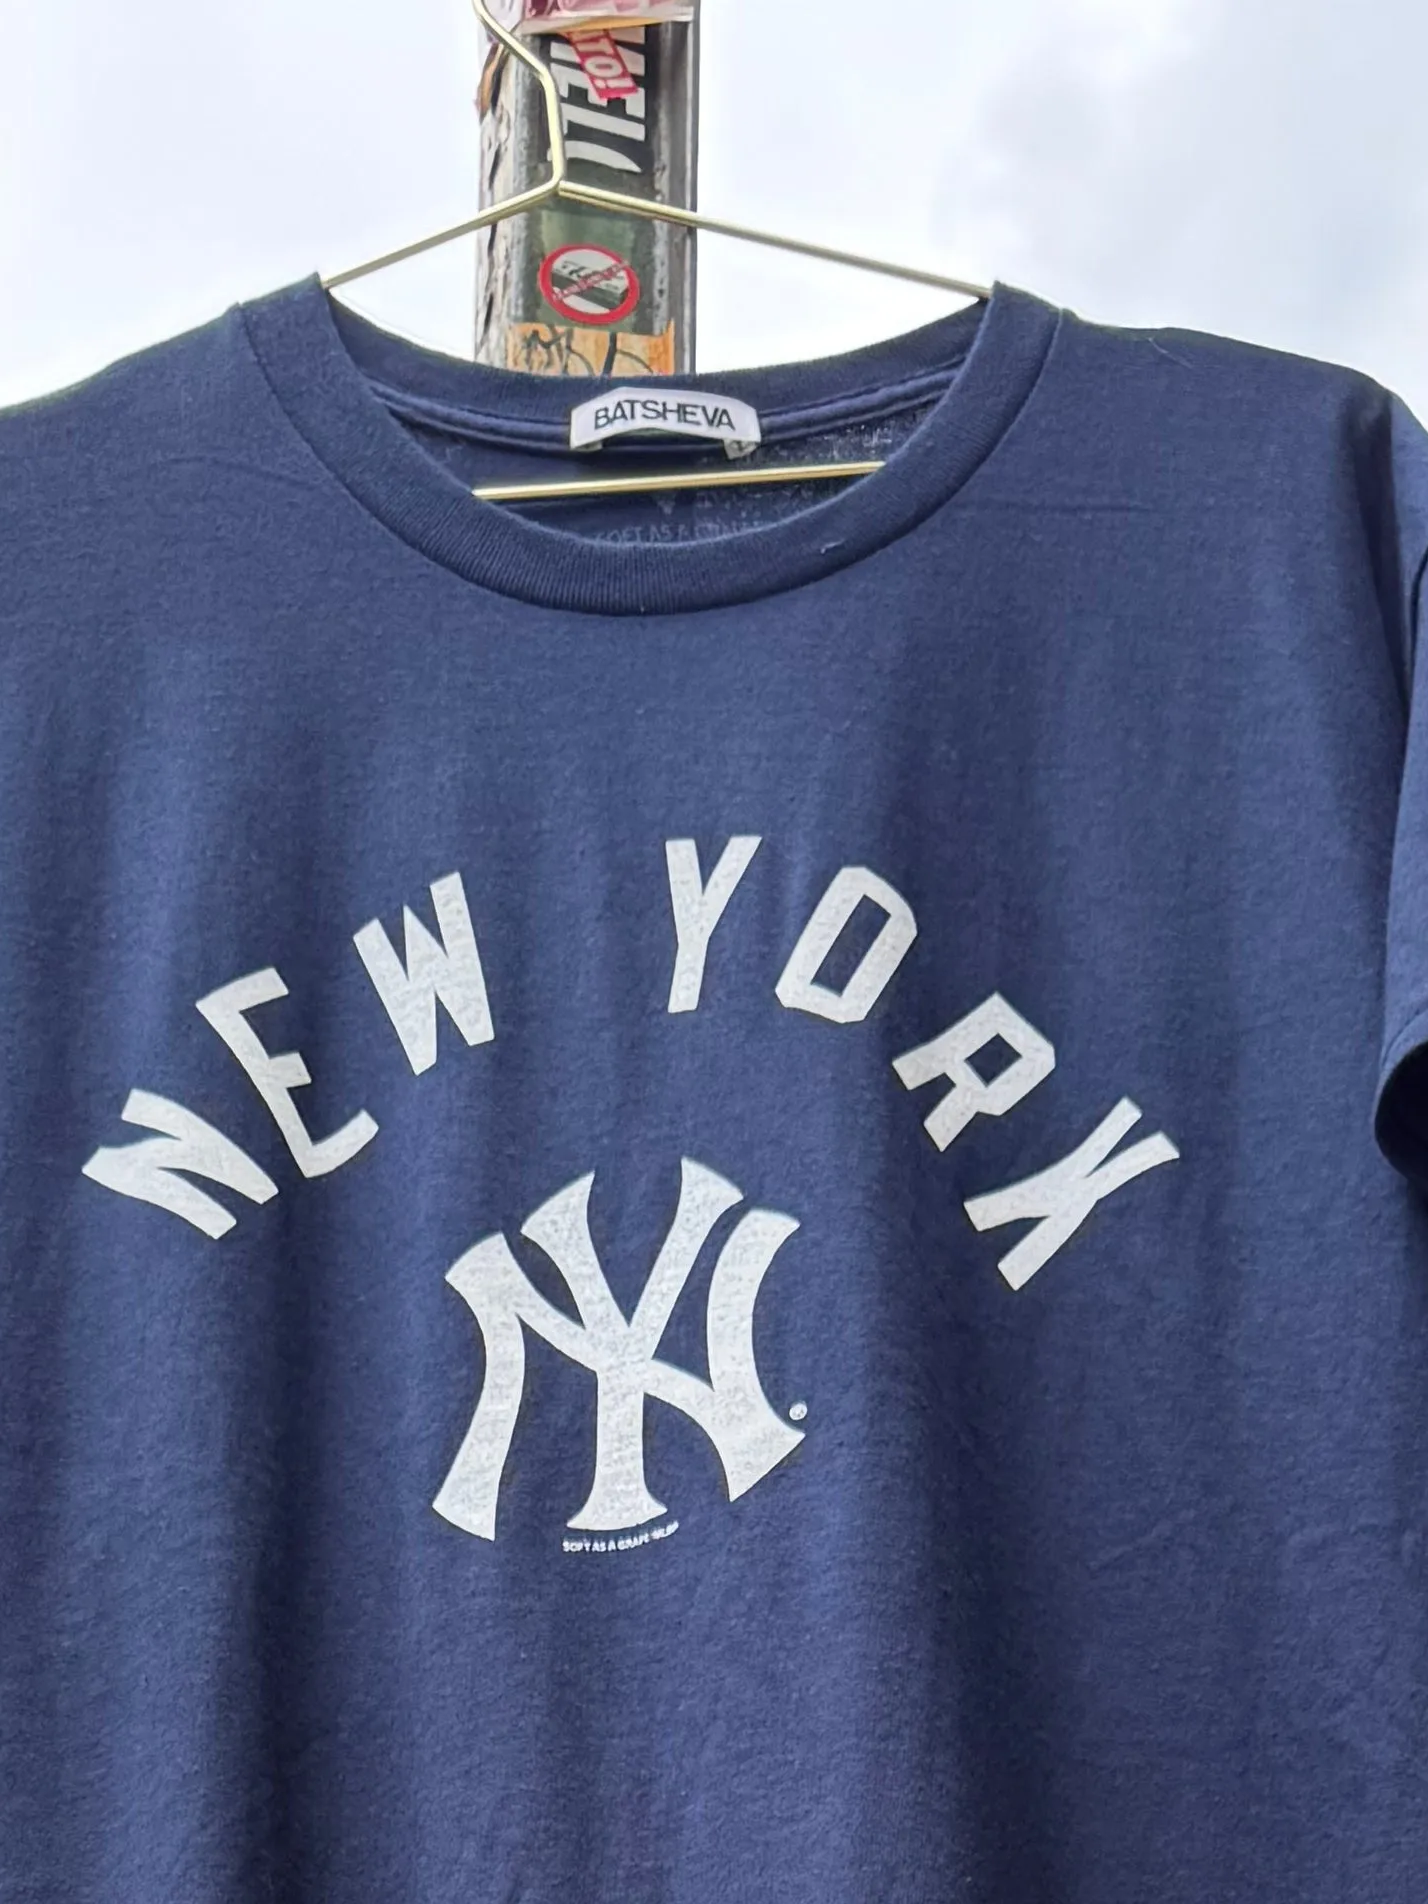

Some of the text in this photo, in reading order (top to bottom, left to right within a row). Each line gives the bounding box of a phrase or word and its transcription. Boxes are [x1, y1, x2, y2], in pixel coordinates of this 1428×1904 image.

[594, 399, 737, 431] BATSHEVA
[82, 835, 1180, 1291] NEW YORK
[431, 1156, 807, 1542] NY
